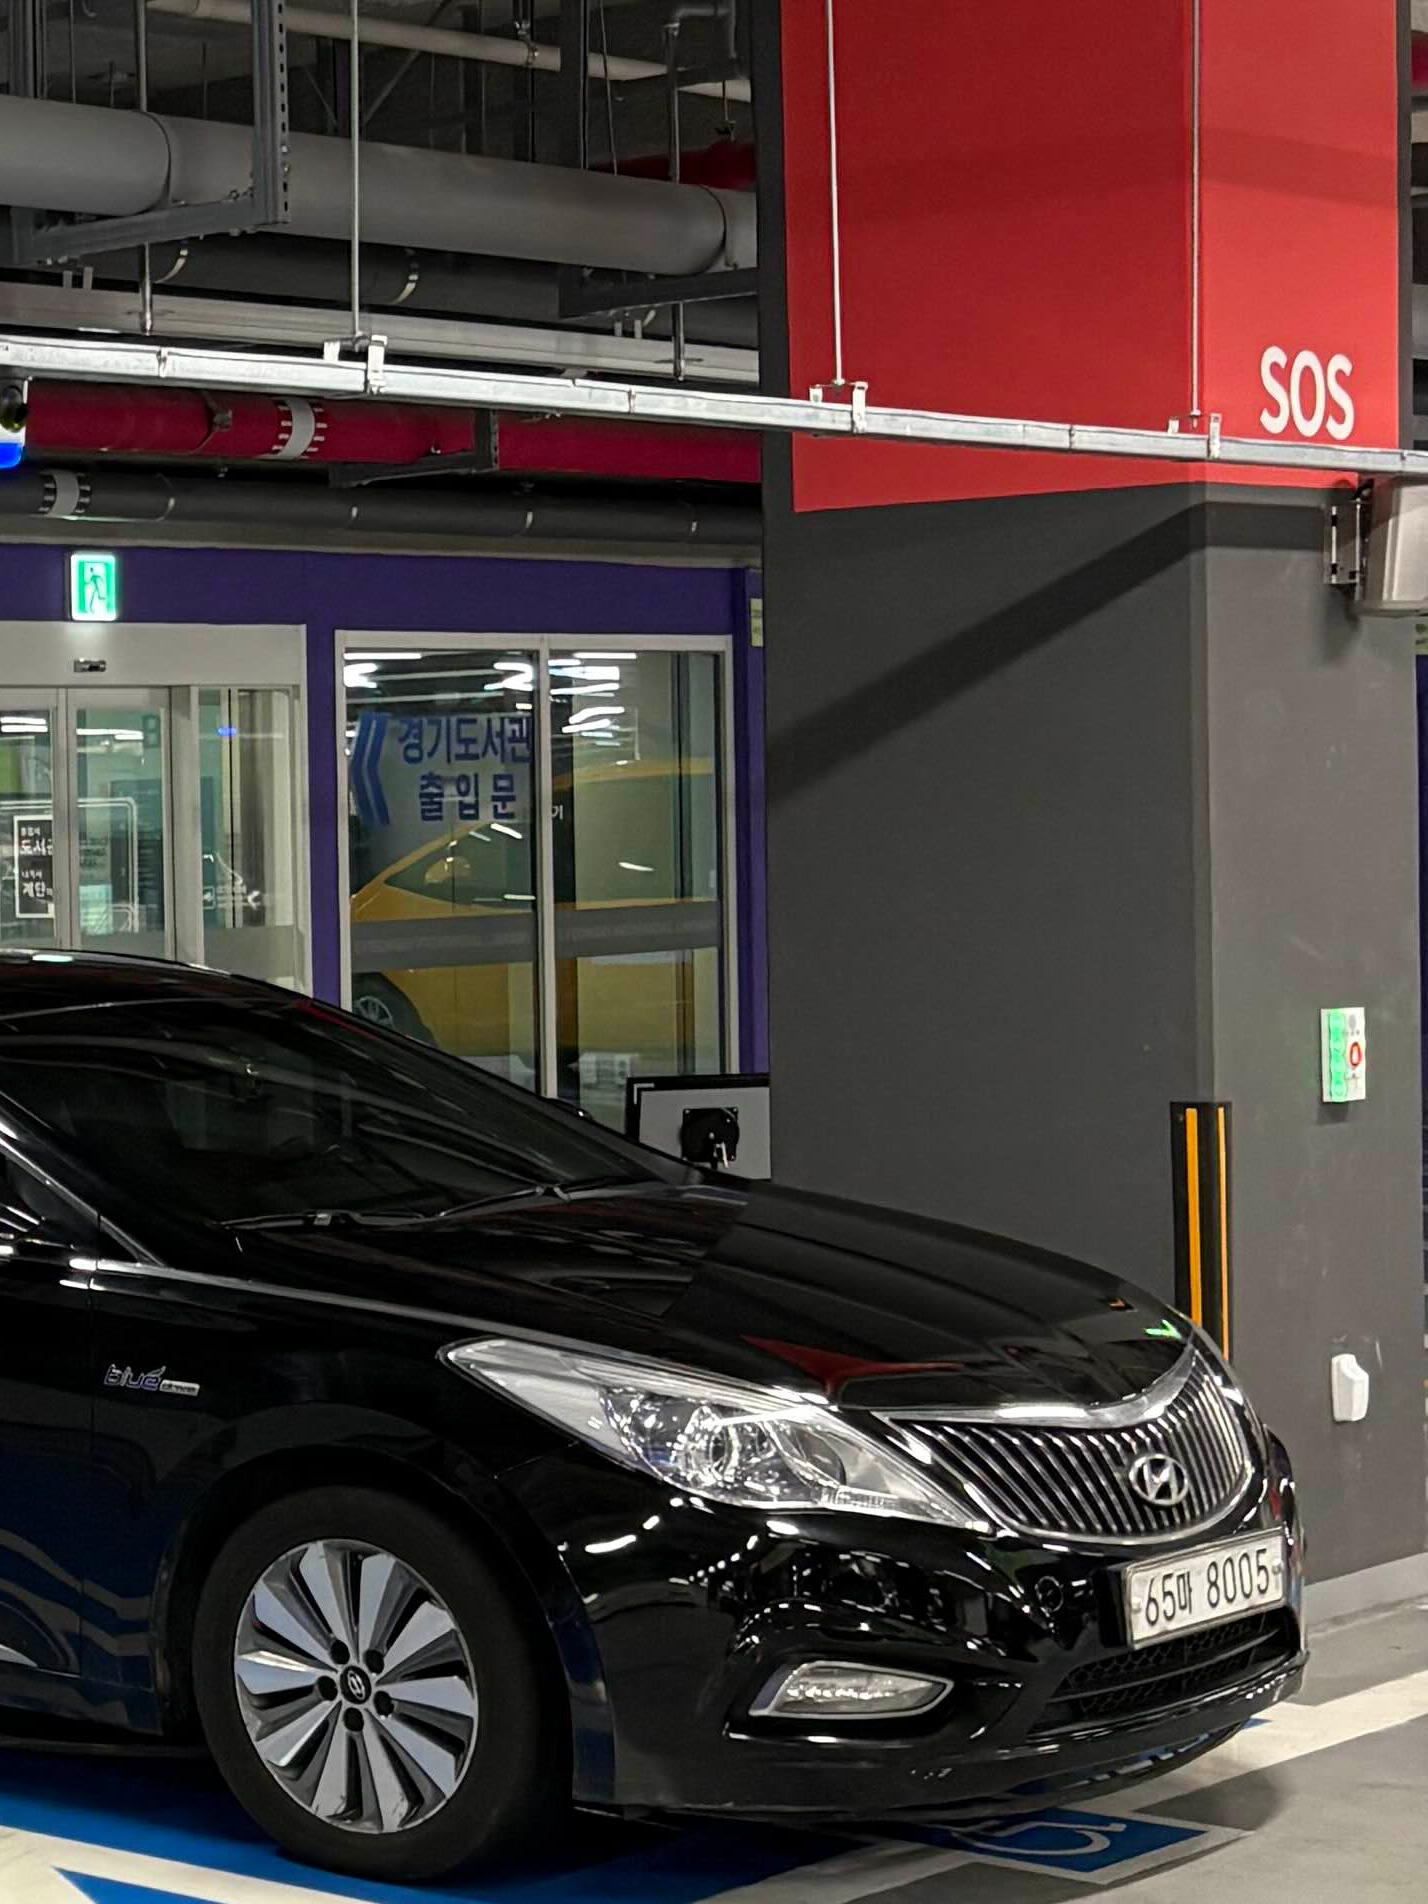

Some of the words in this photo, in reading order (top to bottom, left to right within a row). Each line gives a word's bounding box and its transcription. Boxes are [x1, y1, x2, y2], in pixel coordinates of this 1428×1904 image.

[1259, 345, 1355, 441] SOS
[398, 716, 532, 765] 경기도서관
[1146, 1571, 1193, 1626] 65마
[1207, 1548, 1270, 1608] 8005
